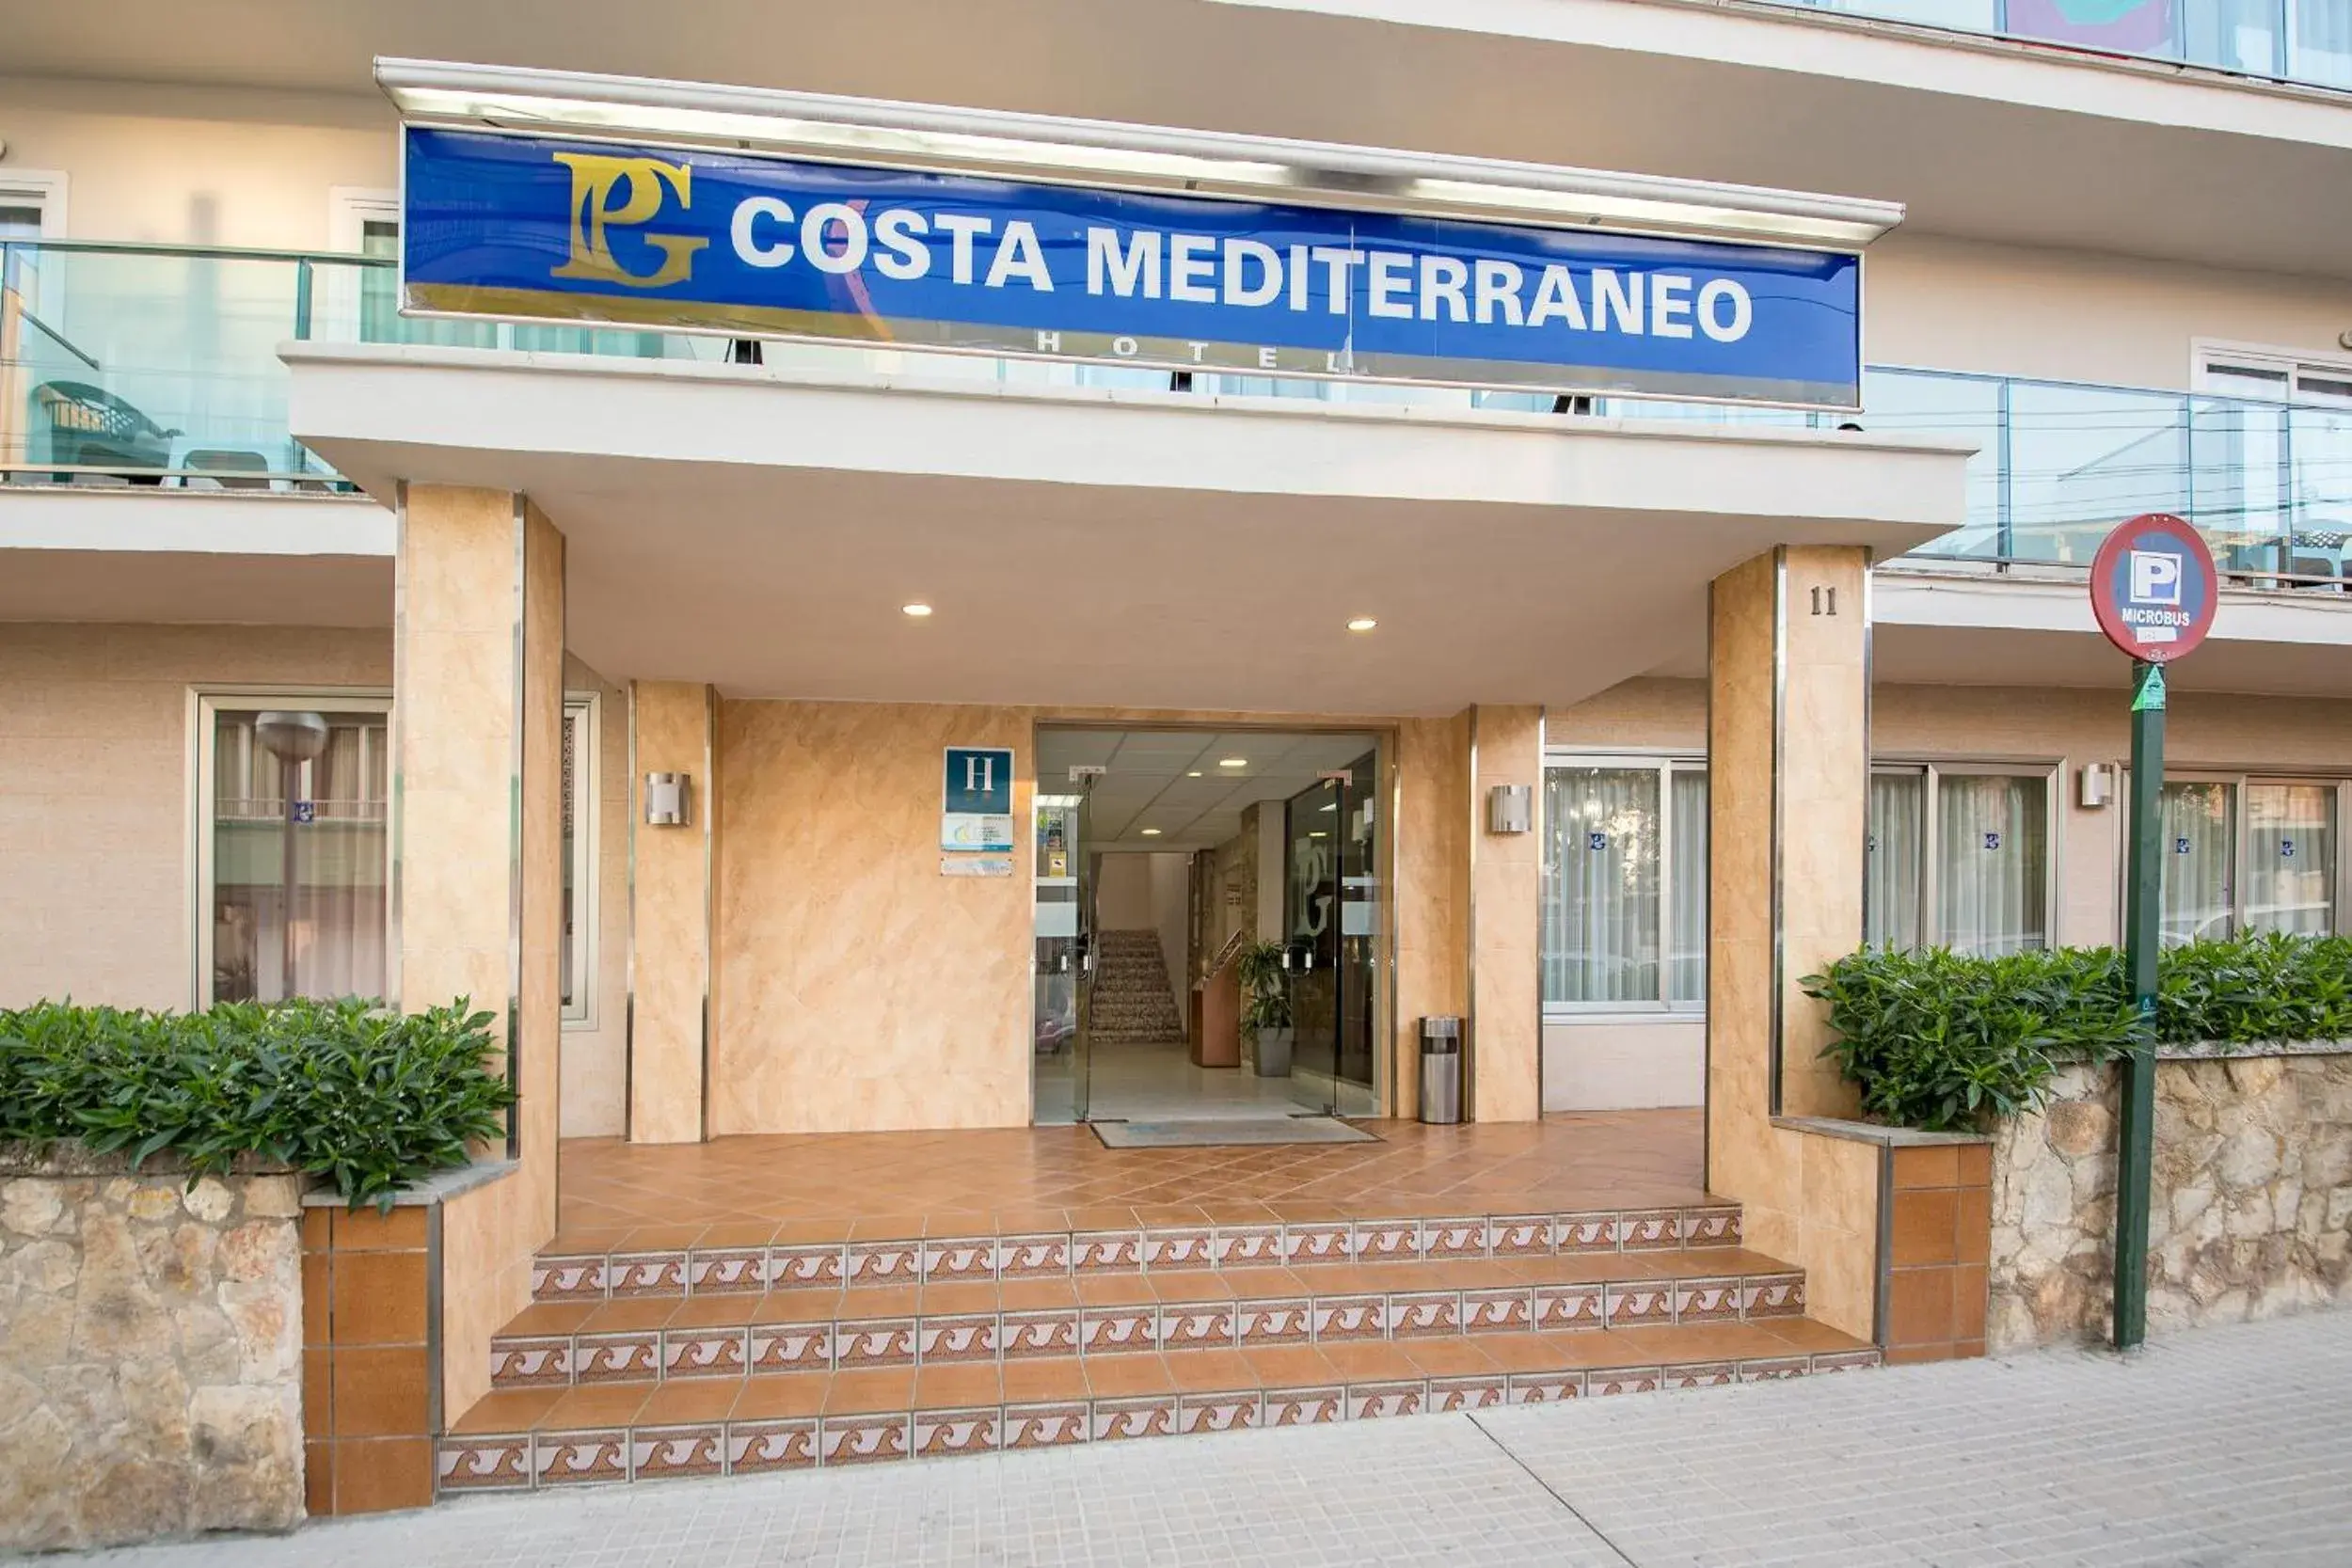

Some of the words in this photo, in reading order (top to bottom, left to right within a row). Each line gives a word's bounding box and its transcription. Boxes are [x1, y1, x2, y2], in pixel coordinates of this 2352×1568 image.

[730, 197, 1054, 292] COSTA
[1087, 229, 1753, 343] MEDITERRANEO
[1037, 330, 1341, 372] HOTEL
[2134, 555, 2177, 598] P
[1810, 585, 1836, 615] 11
[2122, 608, 2190, 626] MICROBUS
[963, 756, 994, 791] H
